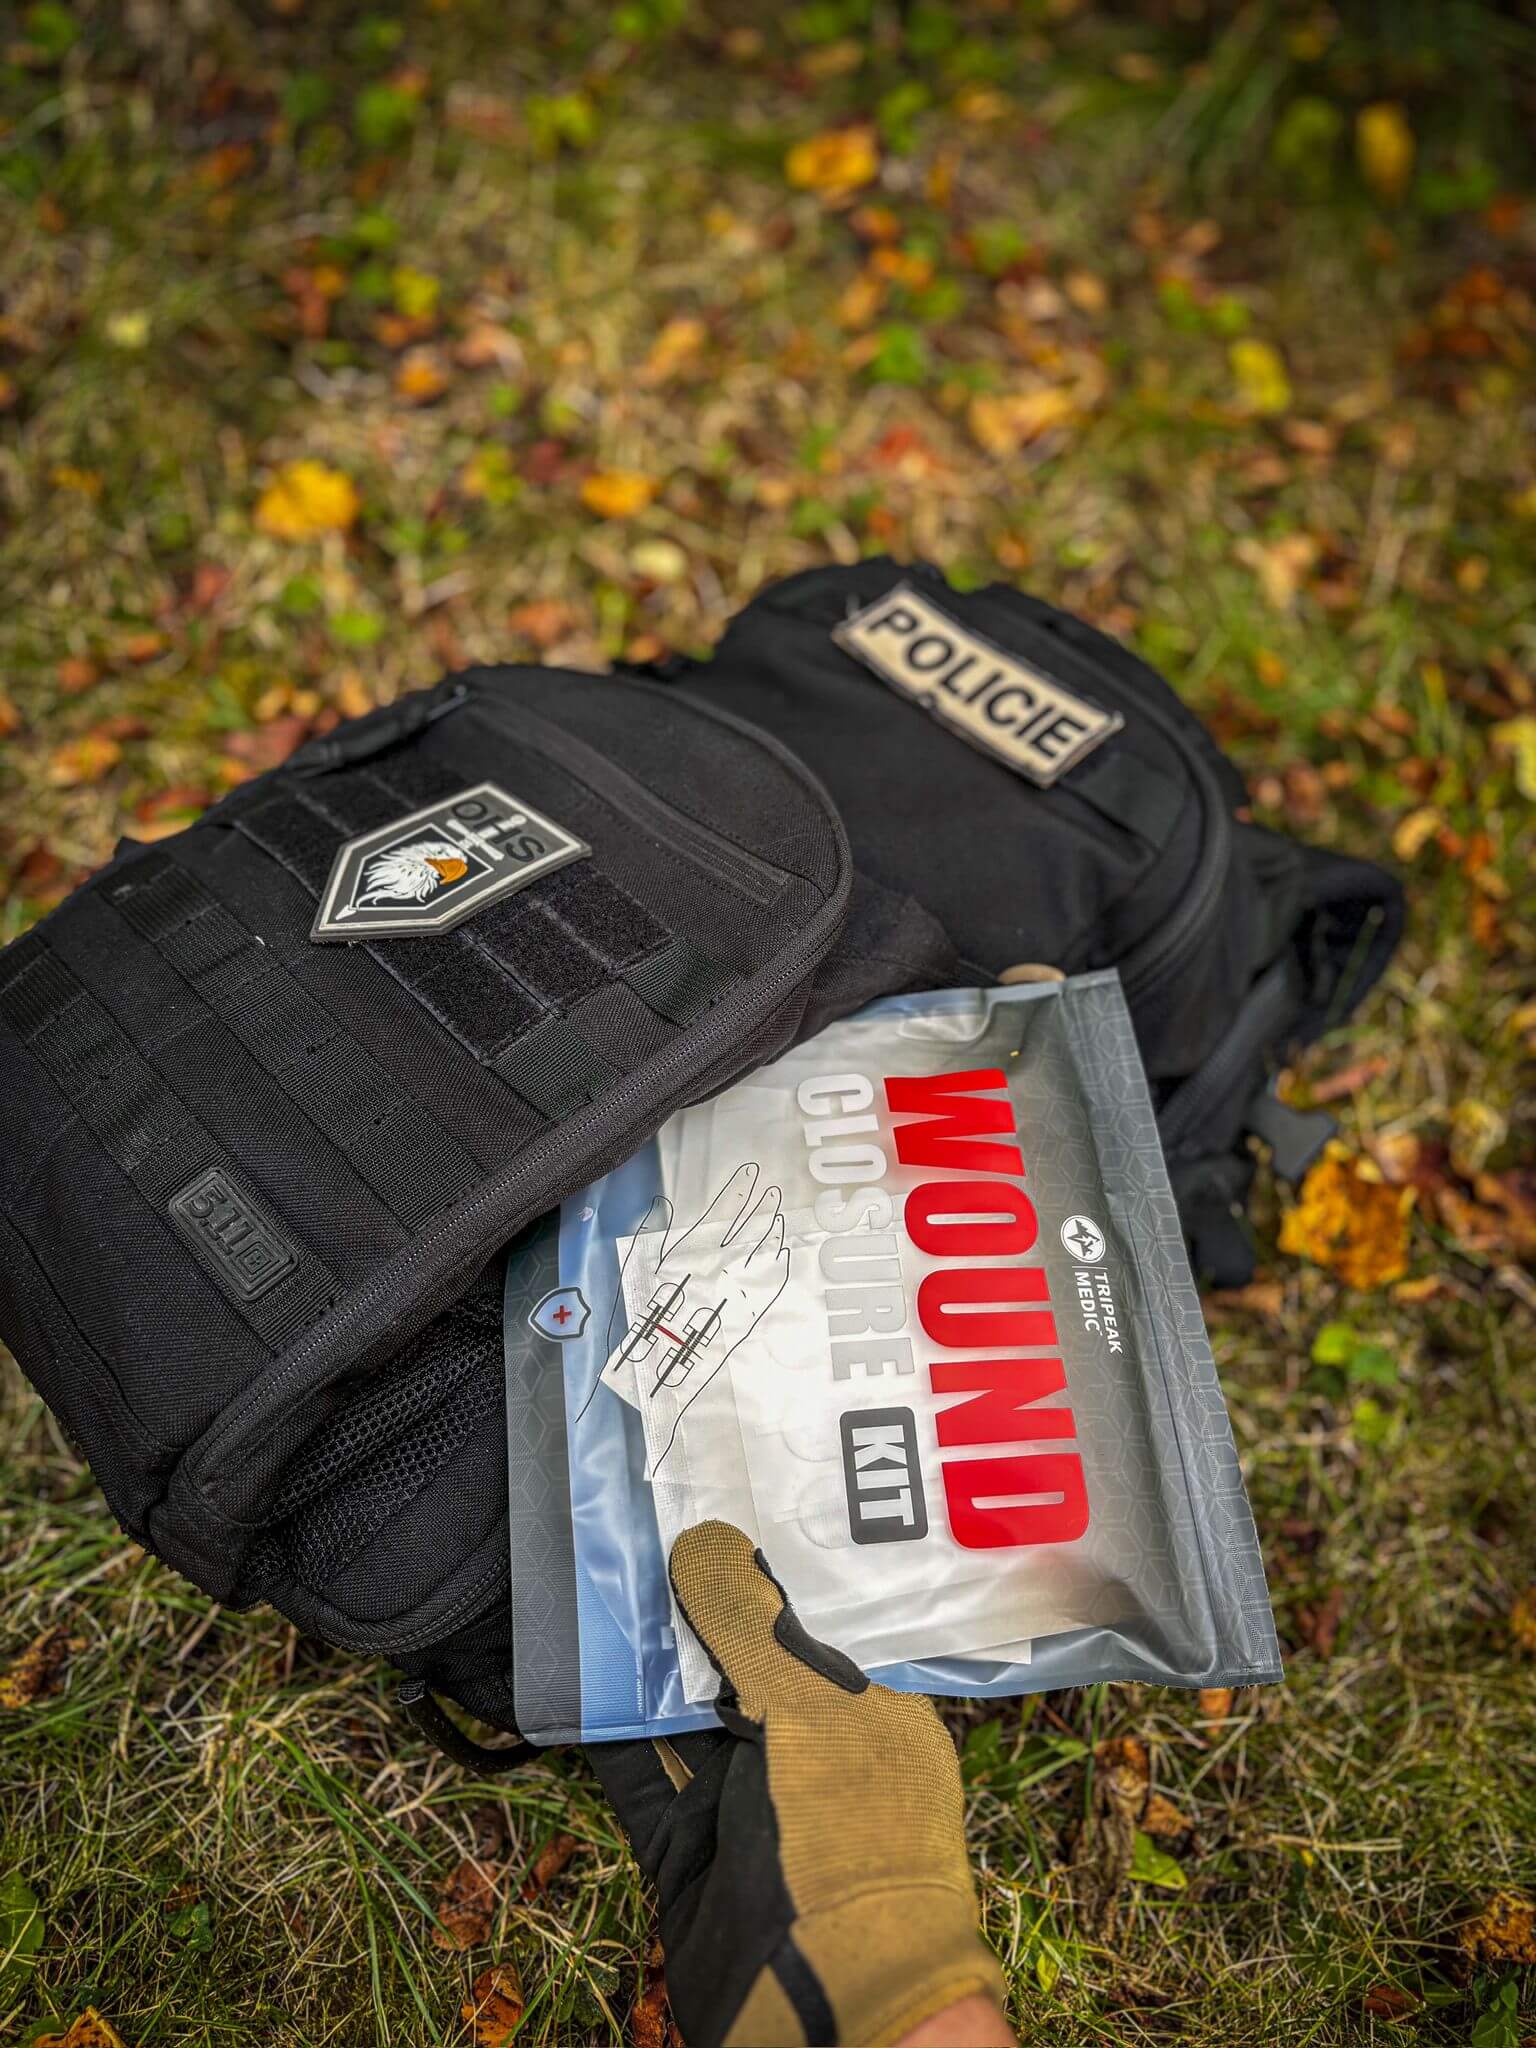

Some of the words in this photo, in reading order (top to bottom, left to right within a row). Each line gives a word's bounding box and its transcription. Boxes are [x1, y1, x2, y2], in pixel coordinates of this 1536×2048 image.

[867, 608, 1087, 759] POLICIE
[452, 799, 547, 863] OHS
[189, 1185, 255, 1256] 5.11
[797, 1072, 916, 1381] CLOSURE
[883, 1068, 1090, 1550] WOUND
[1074, 1271, 1101, 1332] MEDIC
[1094, 1271, 1123, 1355] TRIPEAK
[851, 1424, 915, 1528] KIT
